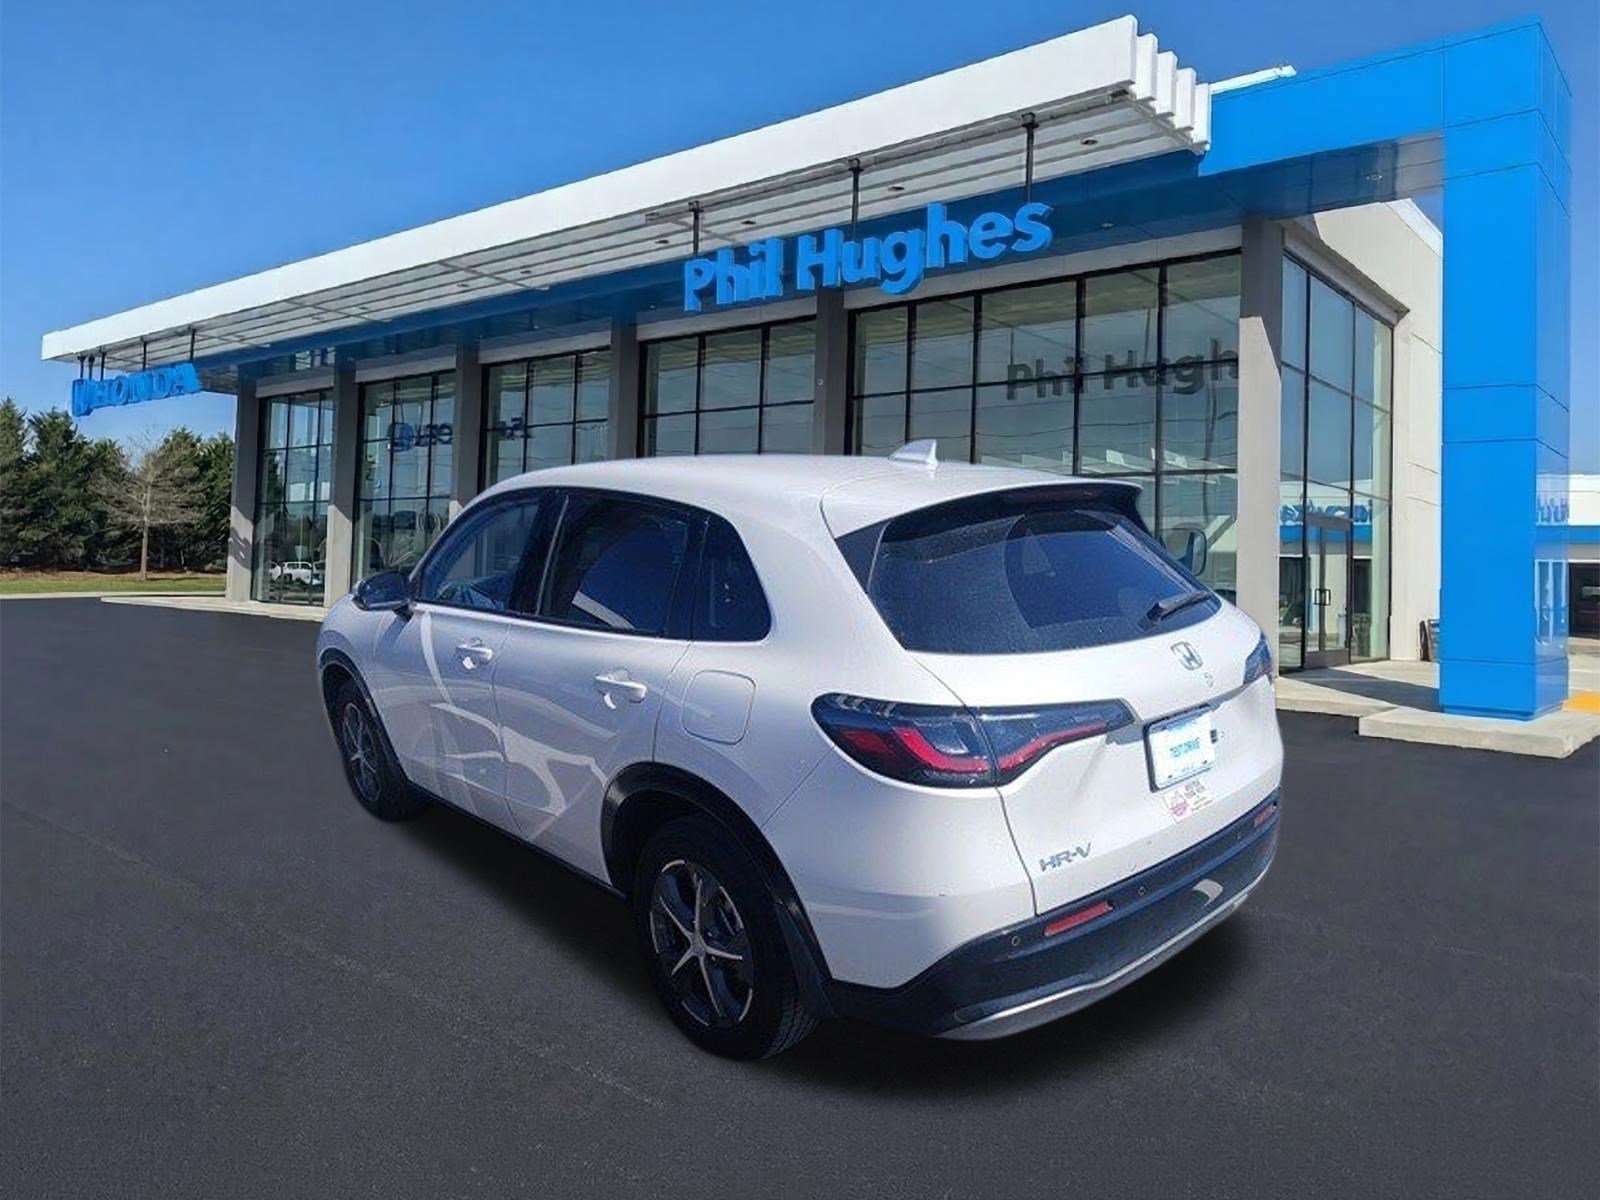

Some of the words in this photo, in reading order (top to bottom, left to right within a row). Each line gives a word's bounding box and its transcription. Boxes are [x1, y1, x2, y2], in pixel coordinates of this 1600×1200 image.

[684, 237, 784, 312] Phil
[796, 202, 1054, 295] Hughes
[92, 362, 199, 409] HONDA
[1040, 842, 1091, 872] HR-V
